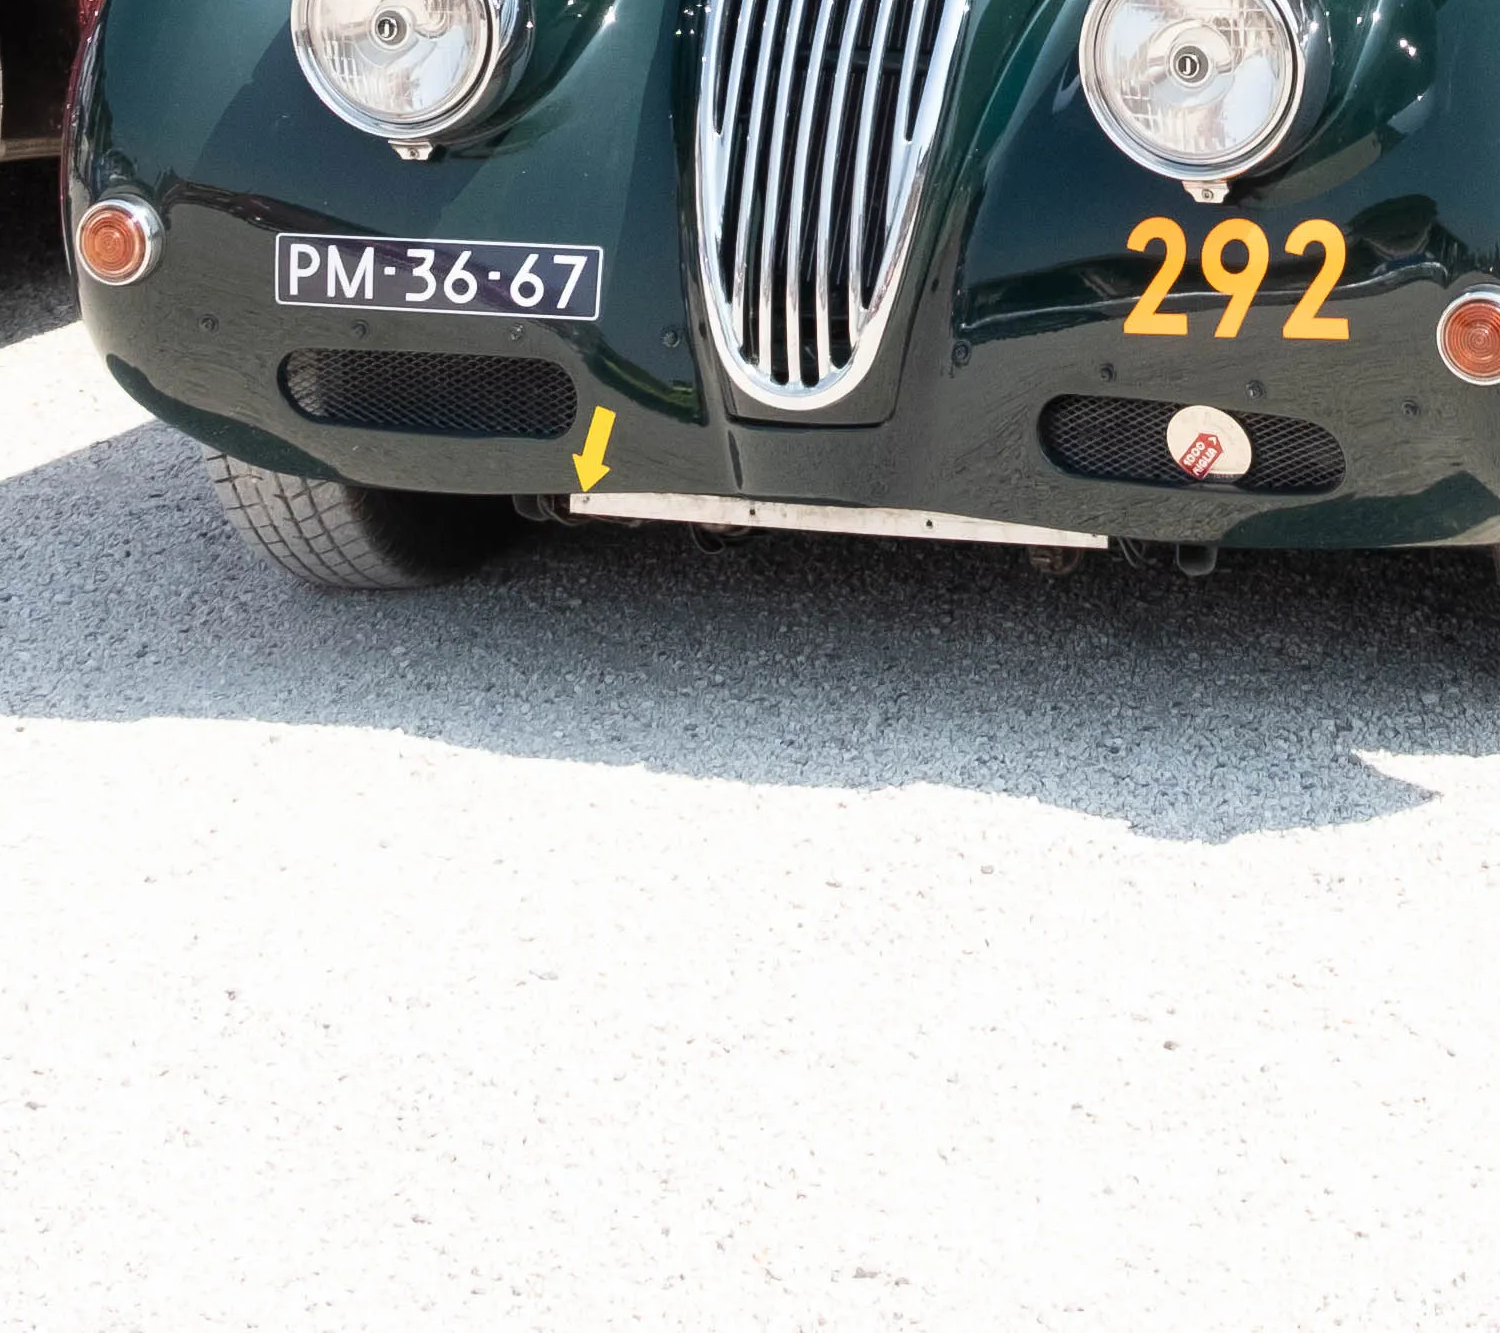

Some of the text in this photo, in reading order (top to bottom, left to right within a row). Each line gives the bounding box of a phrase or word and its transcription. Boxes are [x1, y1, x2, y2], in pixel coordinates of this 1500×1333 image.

[288, 242, 589, 308] PM-36-67
[1123, 216, 1350, 340] 292
[1183, 441, 1206, 467] 1000
